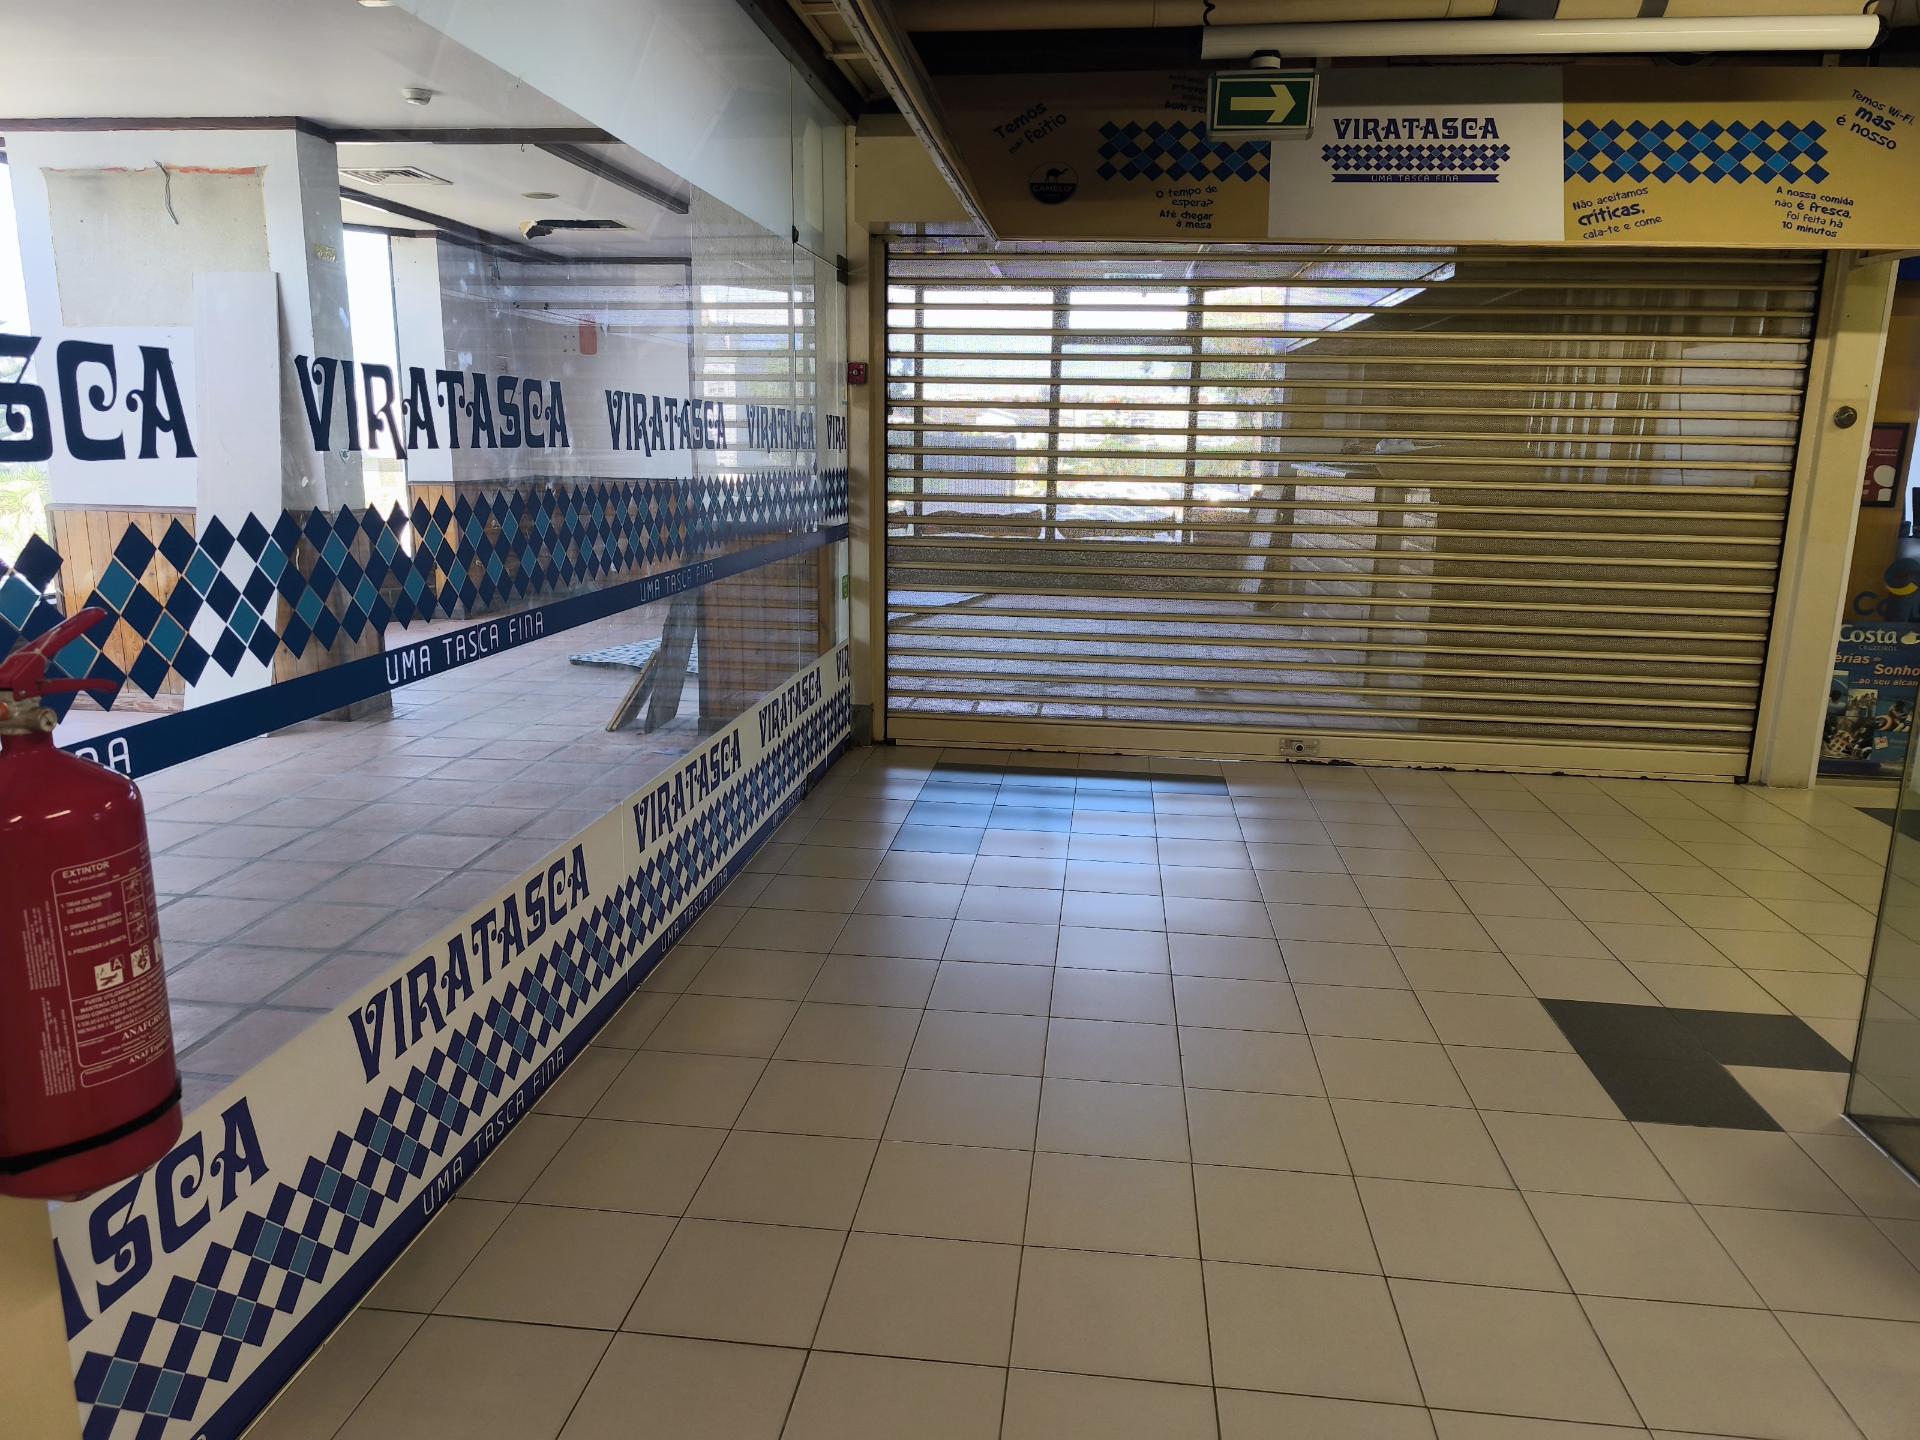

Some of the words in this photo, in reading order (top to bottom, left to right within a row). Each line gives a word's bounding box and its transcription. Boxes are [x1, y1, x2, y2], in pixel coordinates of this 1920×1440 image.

[1851, 88, 1886, 111] Temos
[992, 101, 1048, 140] Temos
[1333, 117, 1500, 142] VIRATASCA
[1854, 106, 1896, 132] mas
[1836, 114, 1847, 126] é
[1850, 122, 1897, 150] nosso
[1371, 174, 1393, 182] UMA
[1399, 174, 1430, 182] TASCA
[1155, 190, 1164, 198] O
[1168, 187, 1202, 198] tempo
[1205, 184, 1217, 193] de
[1572, 200, 1593, 210] Não
[1596, 187, 1649, 205] aceitamos
[1776, 186, 1783, 194] A
[1786, 189, 1817, 200] nossa
[1820, 195, 1854, 206] comida
[1160, 209, 1177, 218] Até
[1180, 211, 1214, 222] chegar
[1774, 199, 1793, 208] não
[1796, 200, 1805, 210] é
[1582, 225, 1621, 240] cala-te
[1634, 216, 1663, 228] come
[1782, 221, 1793, 230] 10
[1796, 224, 1837, 238] minutos
[1787, 210, 1800, 220] foi
[1803, 213, 1827, 225] feita
[0, 333, 199, 463] SCA
[294, 352, 571, 461] VIRATASCA
[604, 389, 728, 458] VIRATASCA
[745, 403, 818, 454] VIRATASCA
[825, 414, 848, 454] VIRA
[640, 578, 661, 602] UMA
[1840, 624, 1897, 644] Costa
[385, 642, 432, 687] UMA
[443, 623, 501, 667] TASCA
[508, 611, 546, 648] FINA
[1835, 651, 1872, 664] érias
[835, 644, 850, 682] VIR
[758, 666, 823, 749] VIRATASCA
[632, 728, 742, 854] VIRATASCA
[62, 860, 110, 879] EXTINTOR
[661, 923, 680, 953] UMA
[683, 890, 709, 928] TASCA
[711, 867, 728, 896] FINA
[112, 957, 123, 971] A
[348, 842, 590, 1085] VIRATASCA
[422, 1155, 464, 1216] UMA
[473, 1096, 526, 1160] TASCA
[532, 1045, 566, 1092] FINA
[53, 1096, 270, 1341] SCA
